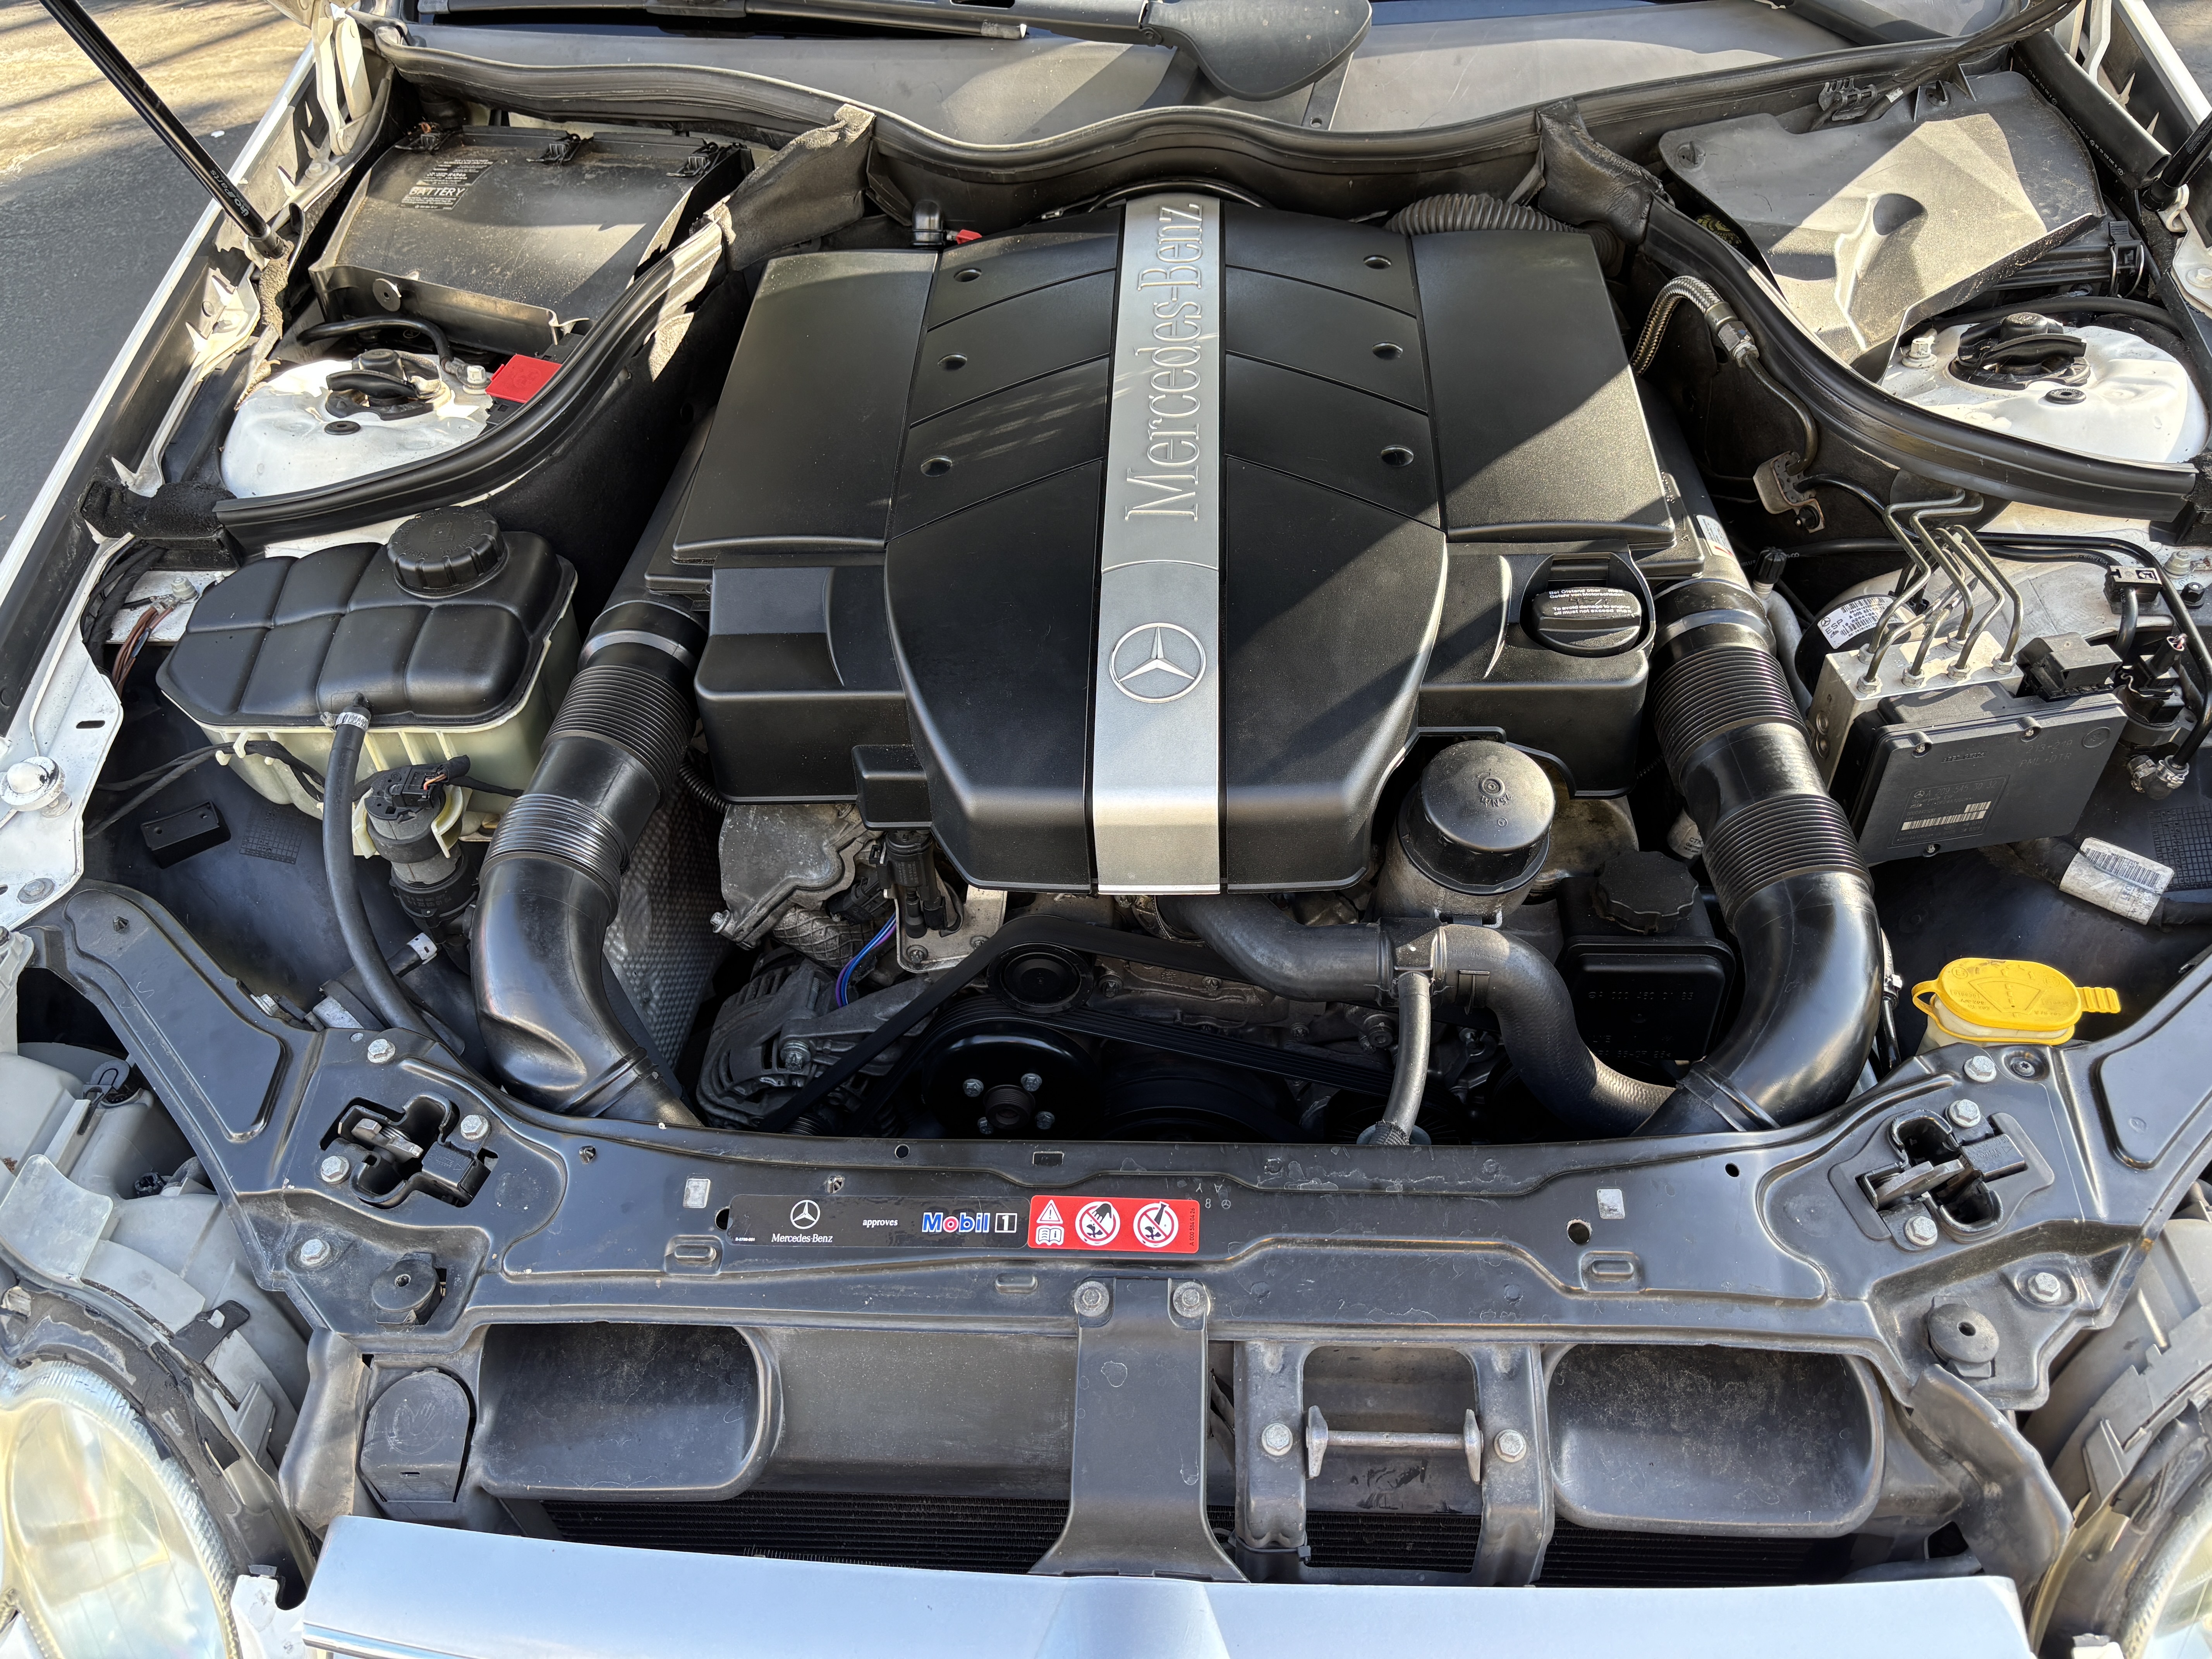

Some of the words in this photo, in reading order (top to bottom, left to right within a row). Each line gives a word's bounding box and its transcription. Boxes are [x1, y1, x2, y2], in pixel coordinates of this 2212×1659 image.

[409, 186, 465, 196] BATTERY
[1125, 203, 1203, 521] Mercedes-Benz
[1825, 618, 1843, 635] ESP
[1954, 785, 1968, 793] 545
[1986, 780, 1997, 789] 32
[862, 1218, 898, 1228] approves
[921, 1212, 990, 1233] Mobil
[771, 1233, 833, 1243] Mercedes-Benz
